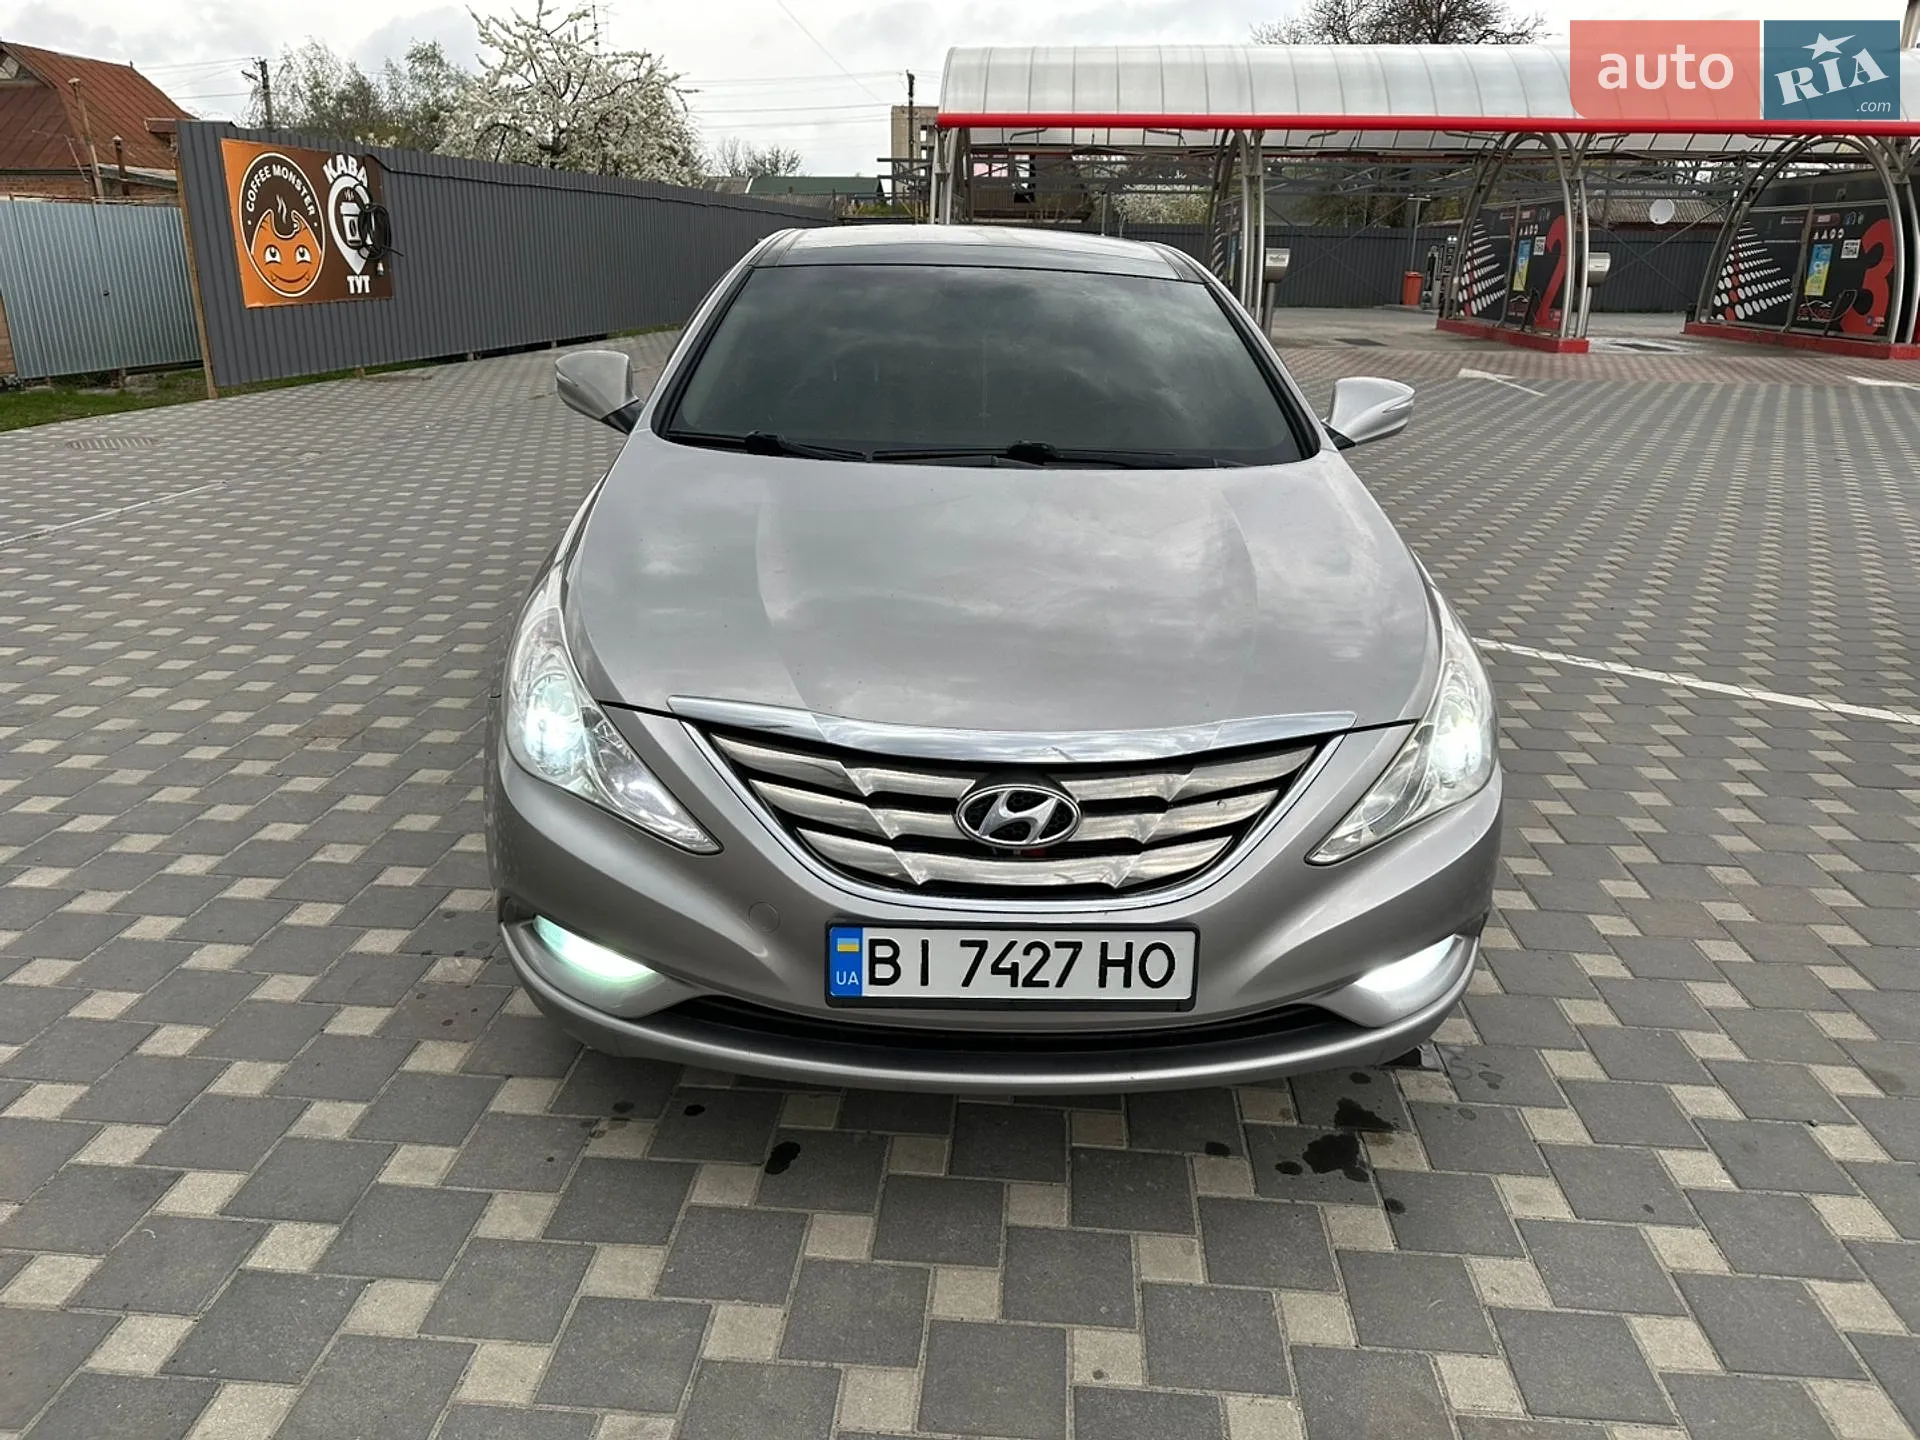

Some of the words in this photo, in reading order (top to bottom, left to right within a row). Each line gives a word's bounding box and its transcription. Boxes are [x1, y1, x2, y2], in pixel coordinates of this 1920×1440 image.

[246, 165, 272, 212] COFFEE
[272, 164, 316, 216] MONSTER
[346, 275, 370, 294] ТУТ
[1533, 214, 1567, 330] 2
[1840, 217, 1895, 336] 3
[835, 970, 860, 986] UA
[959, 939, 1083, 989] 7427
[1098, 940, 1176, 989] HO
